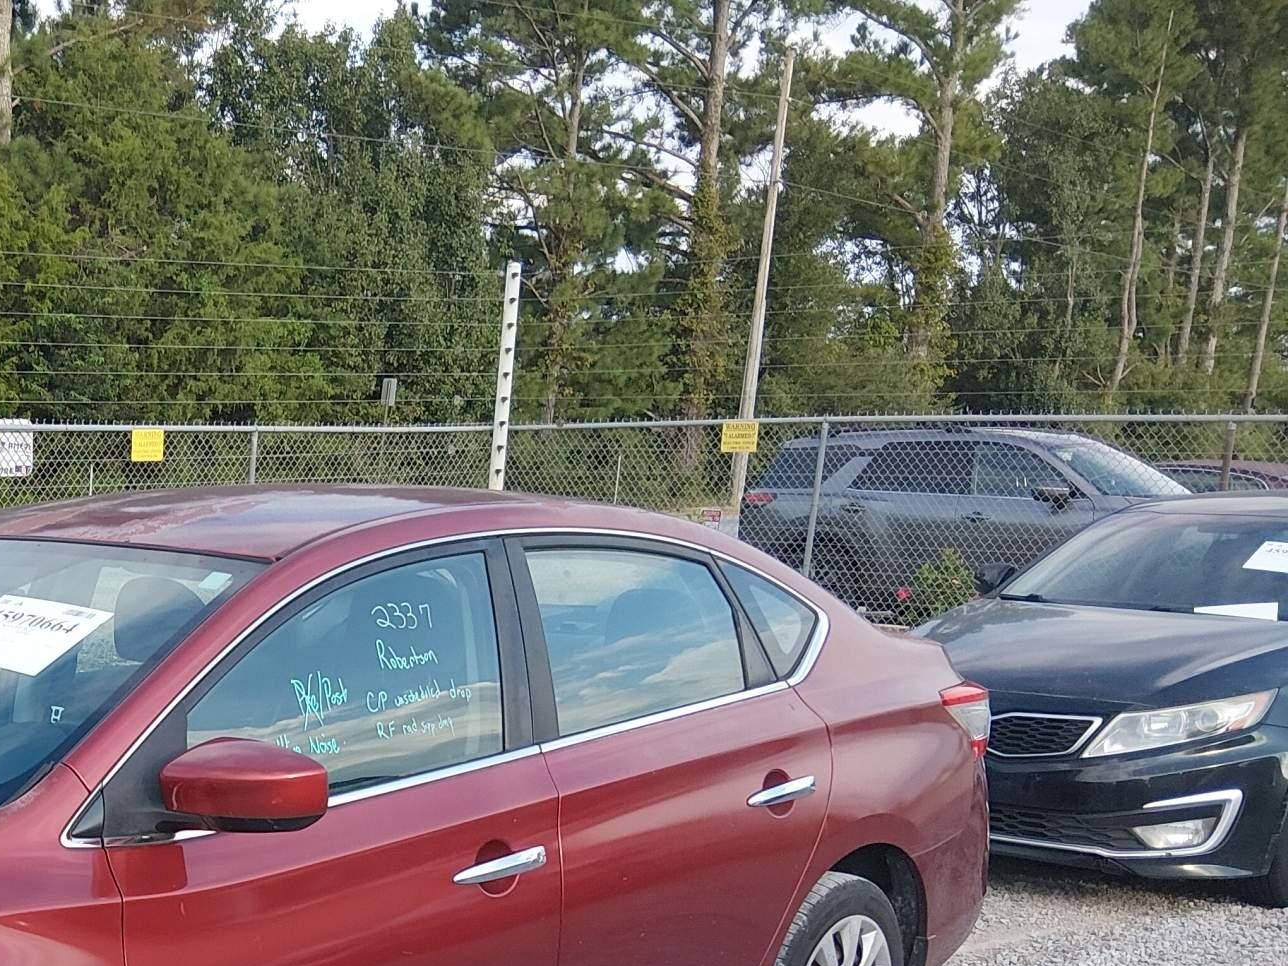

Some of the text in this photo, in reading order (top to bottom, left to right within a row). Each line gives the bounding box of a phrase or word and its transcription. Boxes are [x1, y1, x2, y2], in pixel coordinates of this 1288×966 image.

[371, 602, 433, 630] 2337
[375, 639, 439, 671] Robertson
[366, 691, 388, 713] CP
[449, 678, 472, 704] drop
[376, 721, 396, 740] RF
